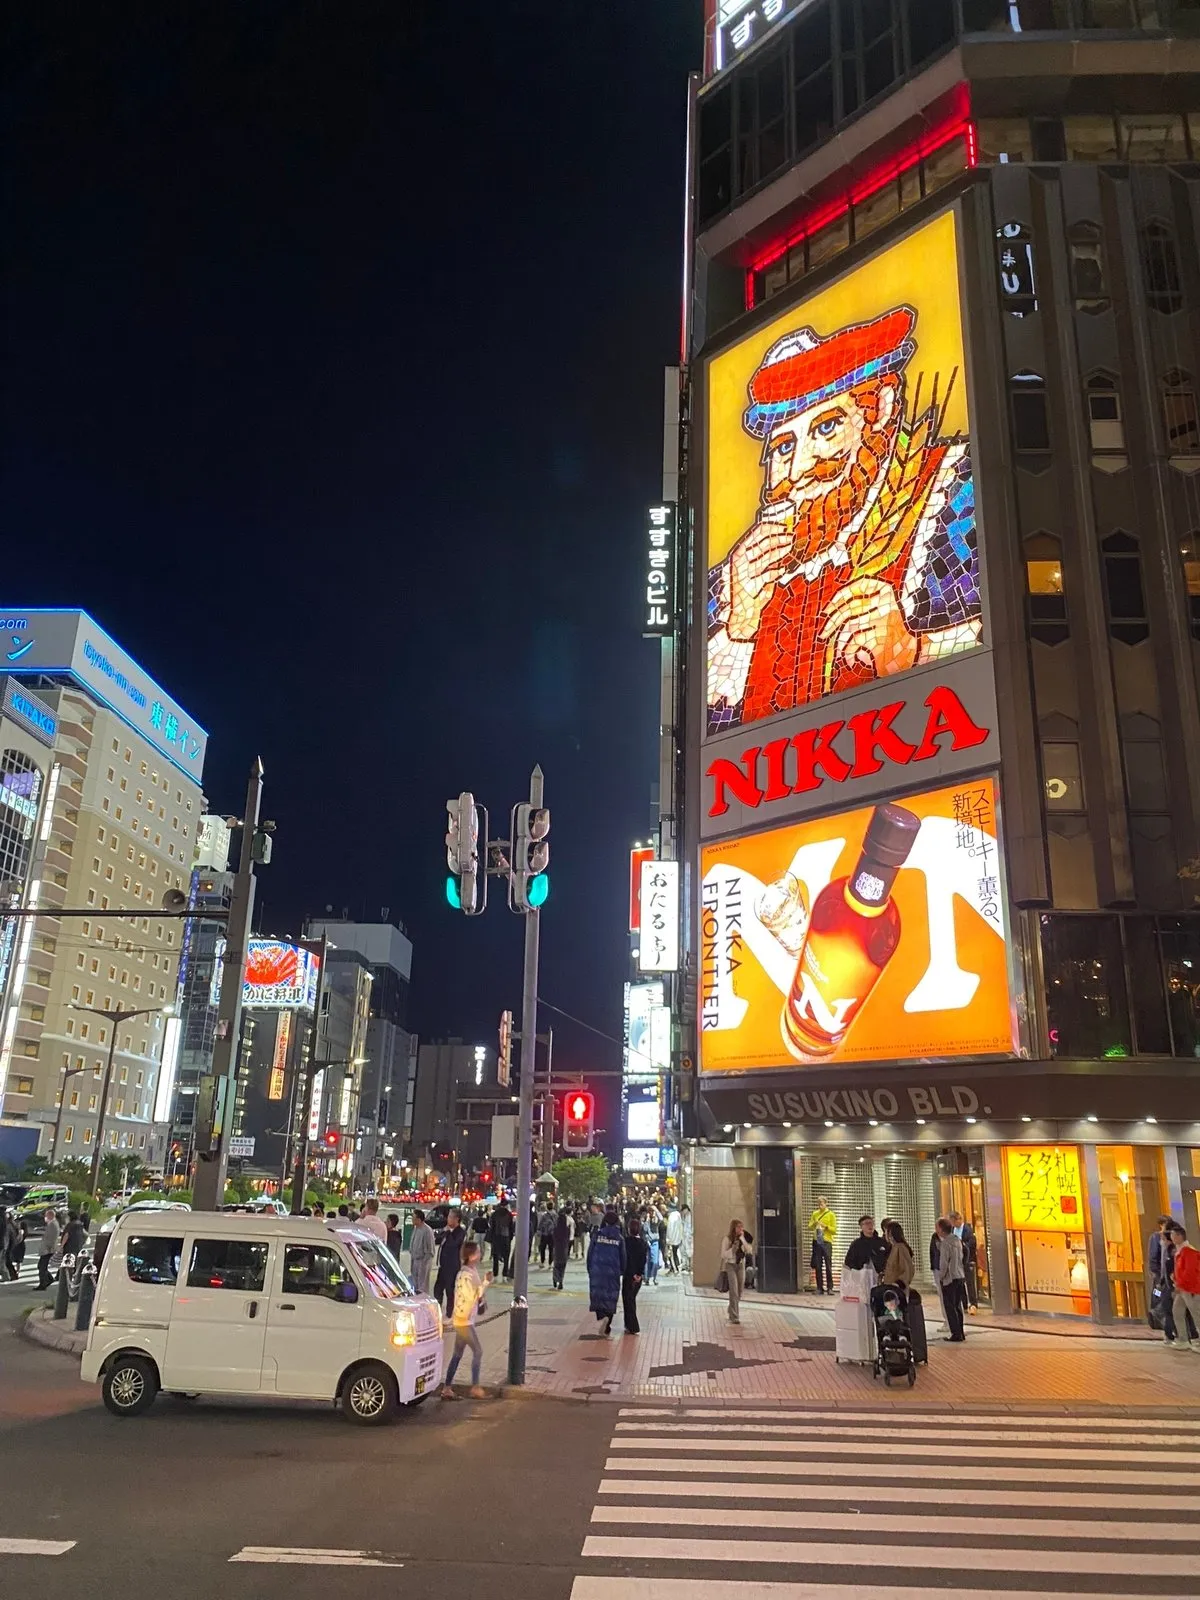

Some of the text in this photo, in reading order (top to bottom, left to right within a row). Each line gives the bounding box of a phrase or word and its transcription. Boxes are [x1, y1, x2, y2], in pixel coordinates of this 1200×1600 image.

[647, 506, 671, 625] すすきのビル
[83, 640, 201, 760] toyoko-inn.com 東横イン
[707, 684, 990, 817] NIKKA
[952, 791, 976, 858] 新境地。
[971, 788, 1000, 923] スモーキー薫る、
[702, 882, 719, 1030] FRONTIER
[725, 877, 743, 975] NIKKA
[747, 1085, 992, 1120] SUSUKINO BLD.
[1018, 1152, 1037, 1222] スクエア
[1037, 1151, 1059, 1221] タイムズ
